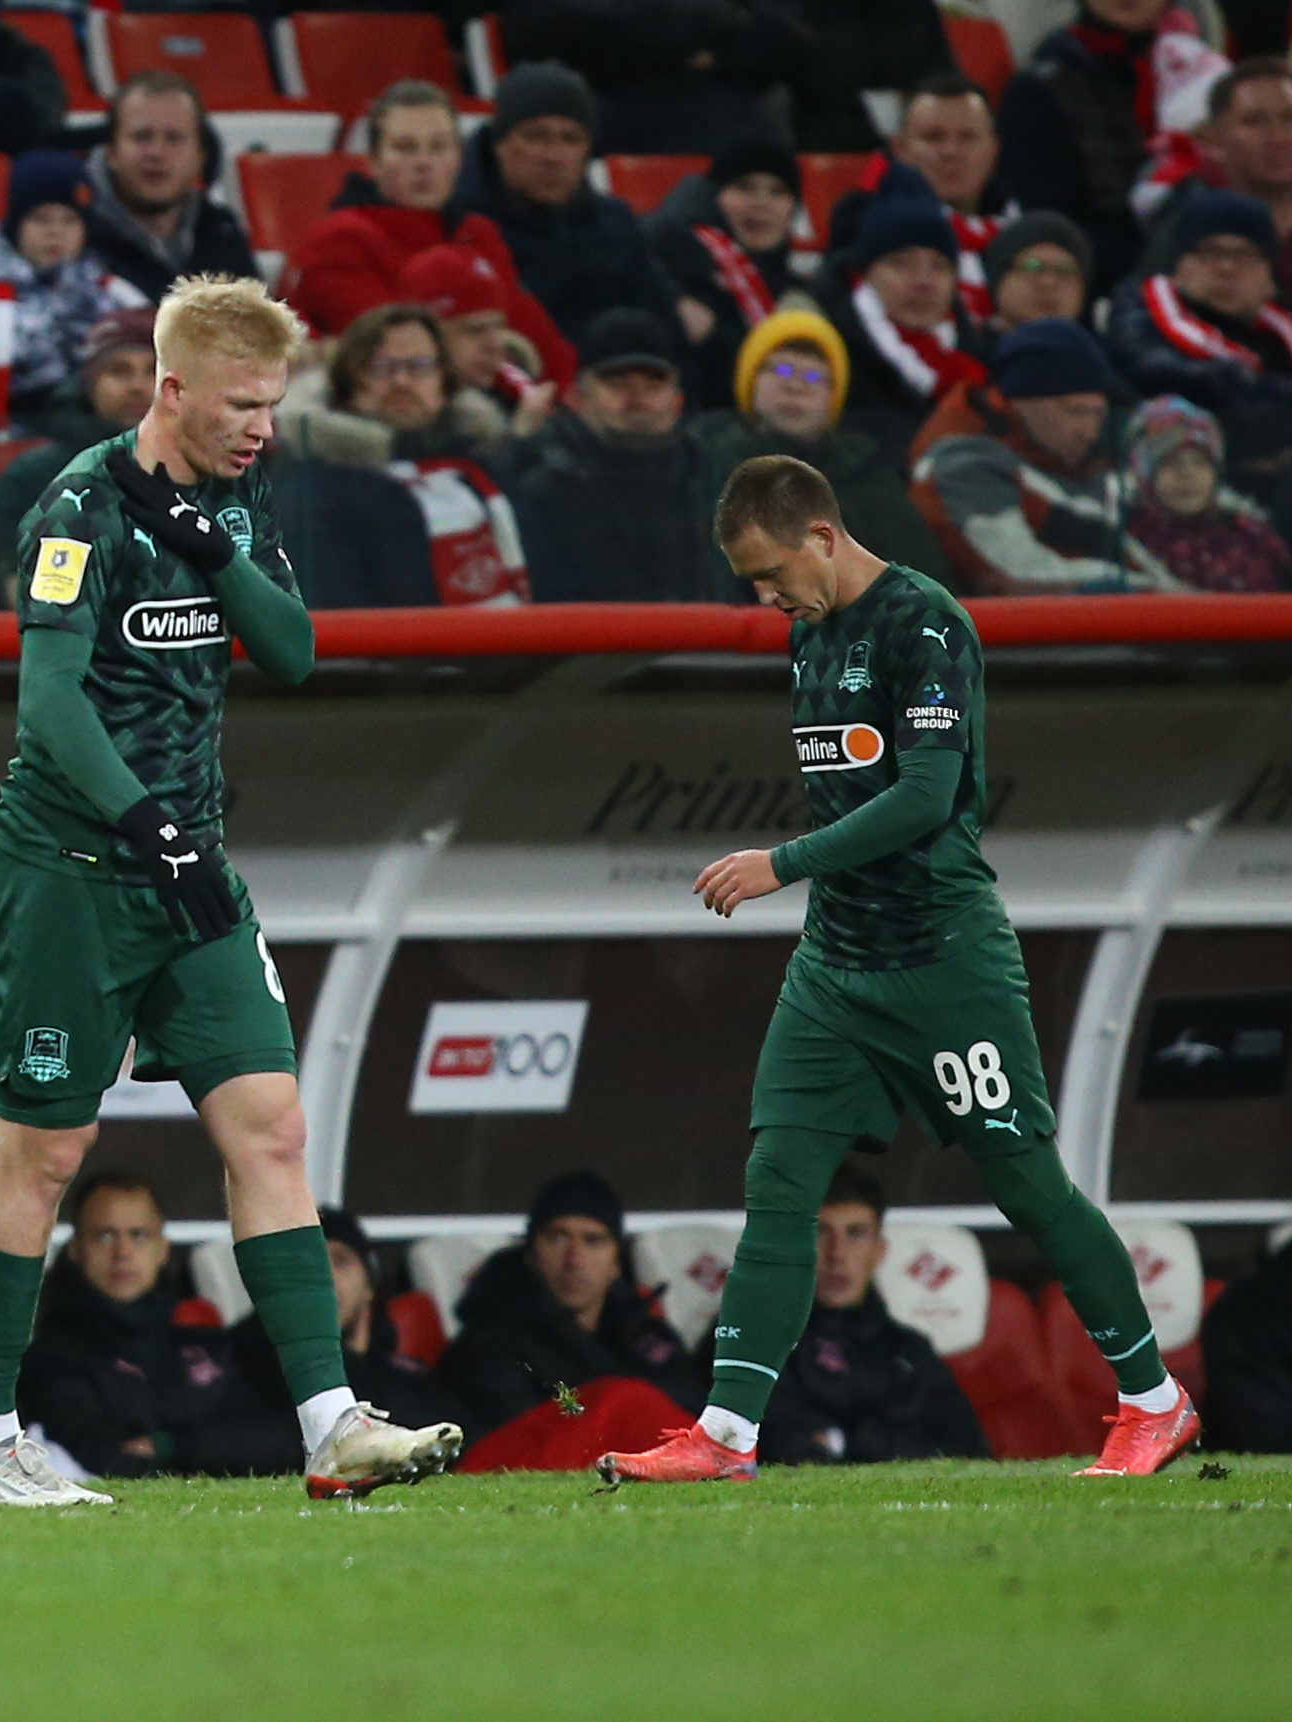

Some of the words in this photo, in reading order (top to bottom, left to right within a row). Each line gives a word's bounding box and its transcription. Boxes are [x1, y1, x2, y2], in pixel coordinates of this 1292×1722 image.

[141, 610, 220, 638] Winline
[906, 706, 960, 721] CONSTELL
[913, 719, 953, 730] GROUP
[795, 737, 839, 762] inline
[933, 1041, 1011, 1116] 98
